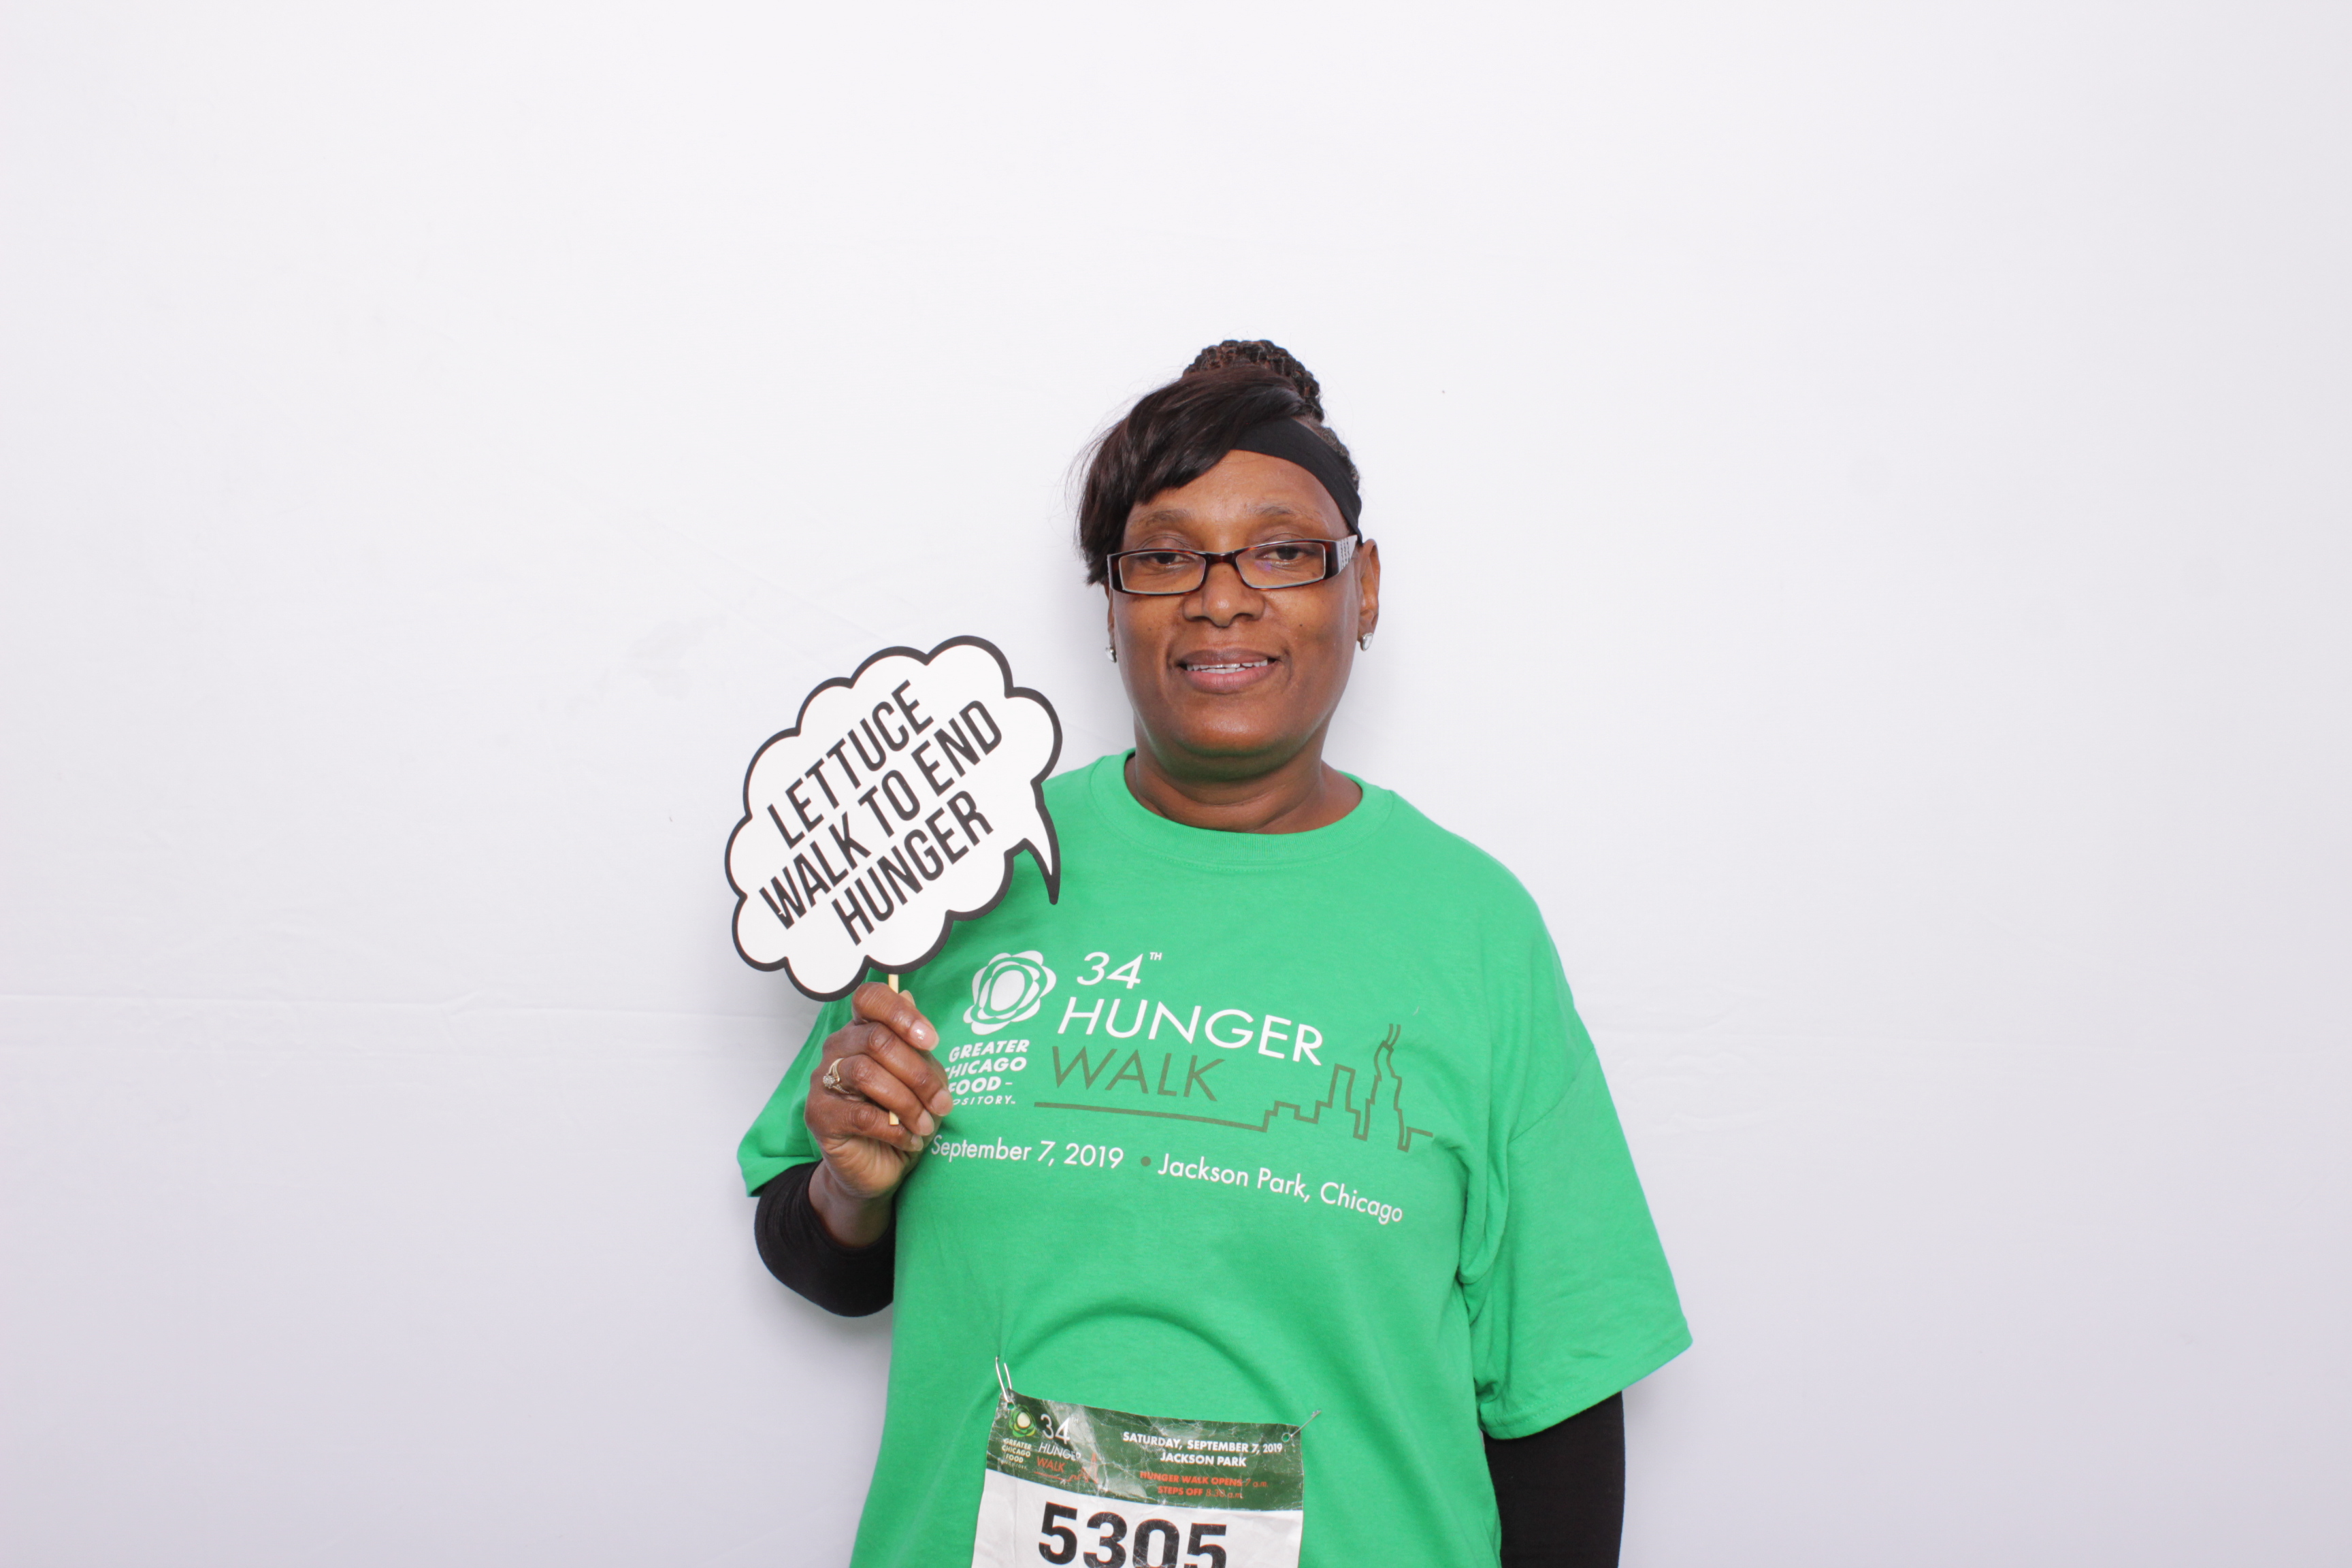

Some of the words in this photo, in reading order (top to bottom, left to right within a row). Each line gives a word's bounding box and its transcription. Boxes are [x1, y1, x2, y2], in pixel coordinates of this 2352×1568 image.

[767, 679, 934, 849] LETTUCE
[759, 811, 871, 929] WALK
[858, 770, 921, 838] TO
[911, 700, 1002, 797] END
[831, 790, 994, 946] HUNGER
[1058, 997, 1322, 1066] HUNGER
[949, 1039, 1030, 1062] GREATER
[1052, 1046, 1225, 1102] WALK
[931, 1134, 1032, 1162] September
[1038, 1141, 1056, 1166] 7,
[1064, 1143, 1124, 1169] 2019
[1158, 1154, 1248, 1186] Jackson
[1257, 1168, 1310, 1202] Park,
[1320, 1182, 1403, 1224] Chicago
[1002, 1446, 1031, 1458] CHICAGO
[1003, 1438, 1032, 1450] GREATER
[1039, 1442, 1081, 1461] HUNGER
[1123, 1431, 1183, 1450] SATURDAY,
[1187, 1440, 1248, 1453] SEPTEMBER
[1252, 1443, 1260, 1455] 7,
[1263, 1443, 1283, 1453] 2019
[1006, 1454, 1024, 1463] FOOD
[1036, 1456, 1066, 1472] WALK
[1160, 1452, 1214, 1465] JACKSON
[1217, 1456, 1247, 1467] PARK
[1140, 1471, 1179, 1483] HUNGER
[1181, 1476, 1209, 1484] WALK
[1211, 1477, 1243, 1486] OPENS
[1158, 1486, 1183, 1495] STEPS
[1186, 1488, 1203, 1496] OFF
[1039, 1501, 1226, 1568] 5305
